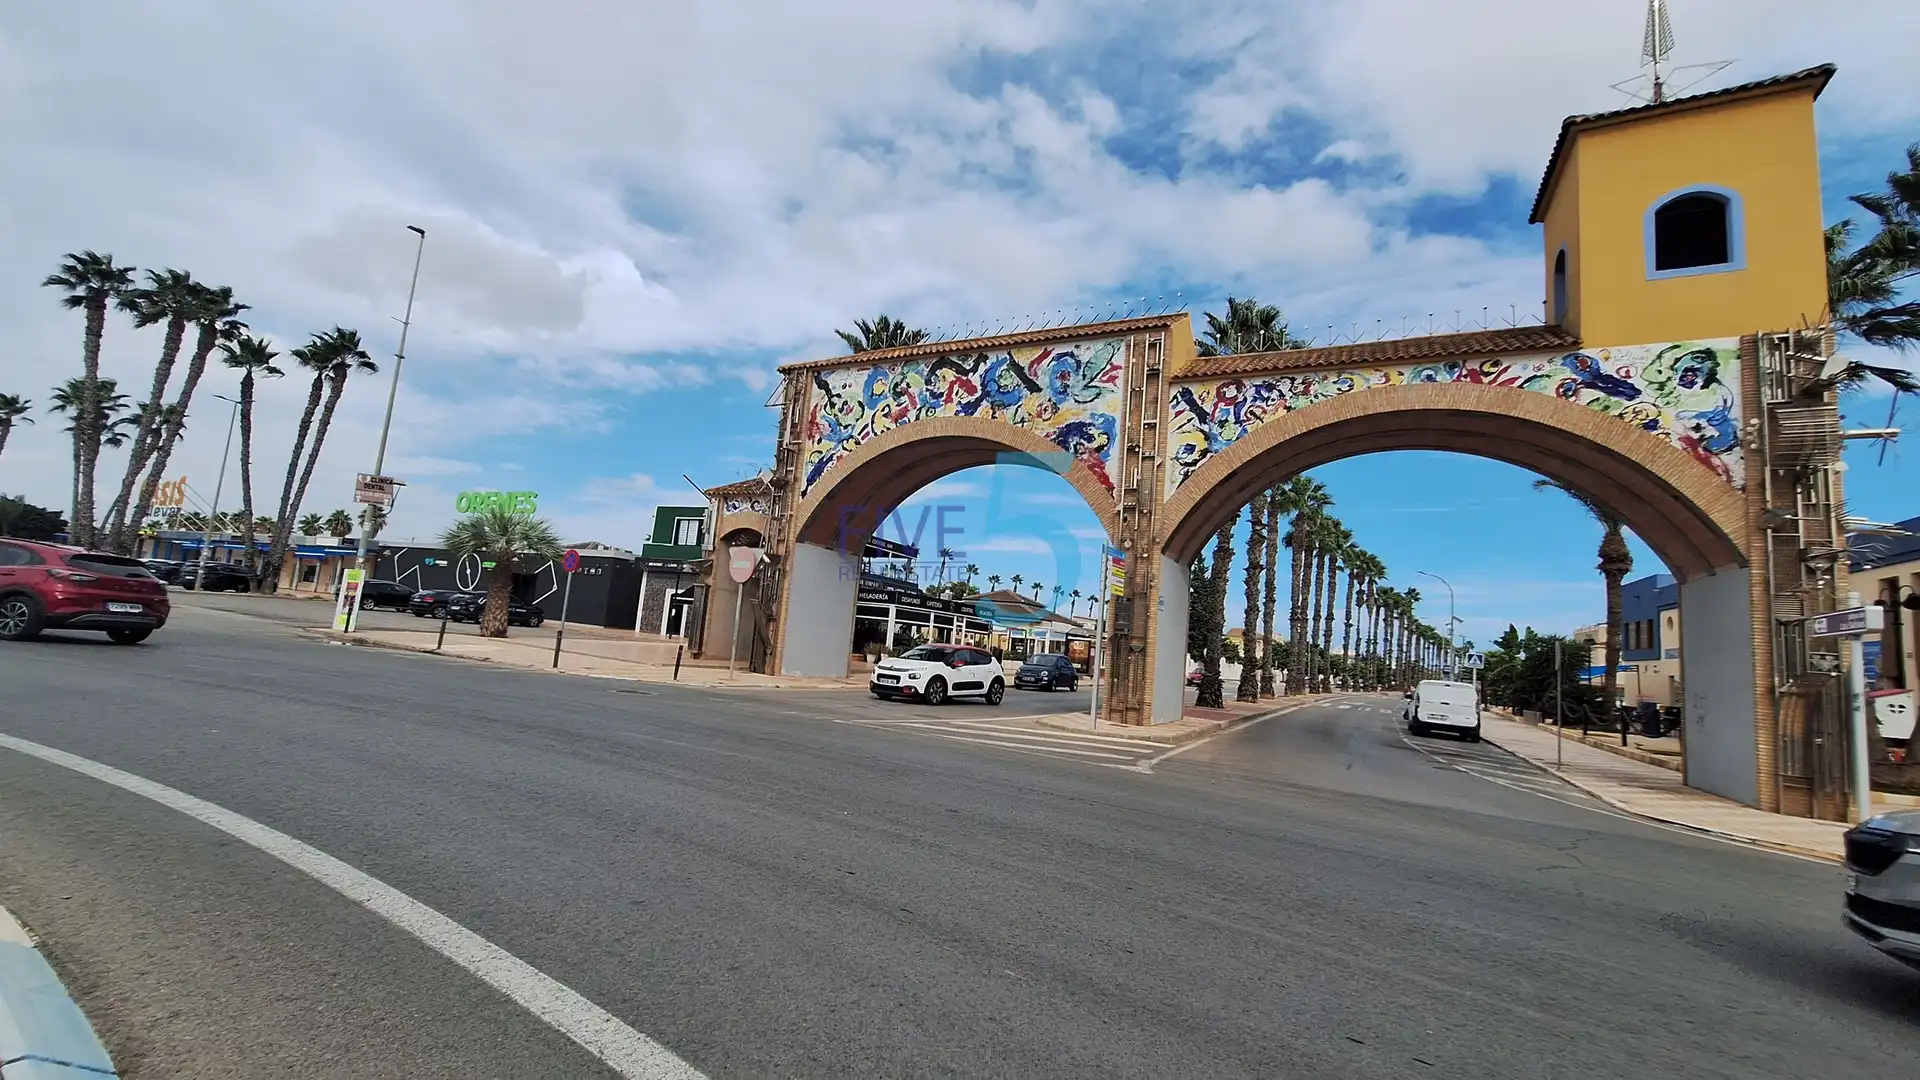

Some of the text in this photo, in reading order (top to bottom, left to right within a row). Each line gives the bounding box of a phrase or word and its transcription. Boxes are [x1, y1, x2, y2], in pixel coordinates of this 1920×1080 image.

[364, 482, 385, 490] DENTAL
[456, 492, 538, 514] ORENES
[859, 592, 888, 600] HELADERÍA
